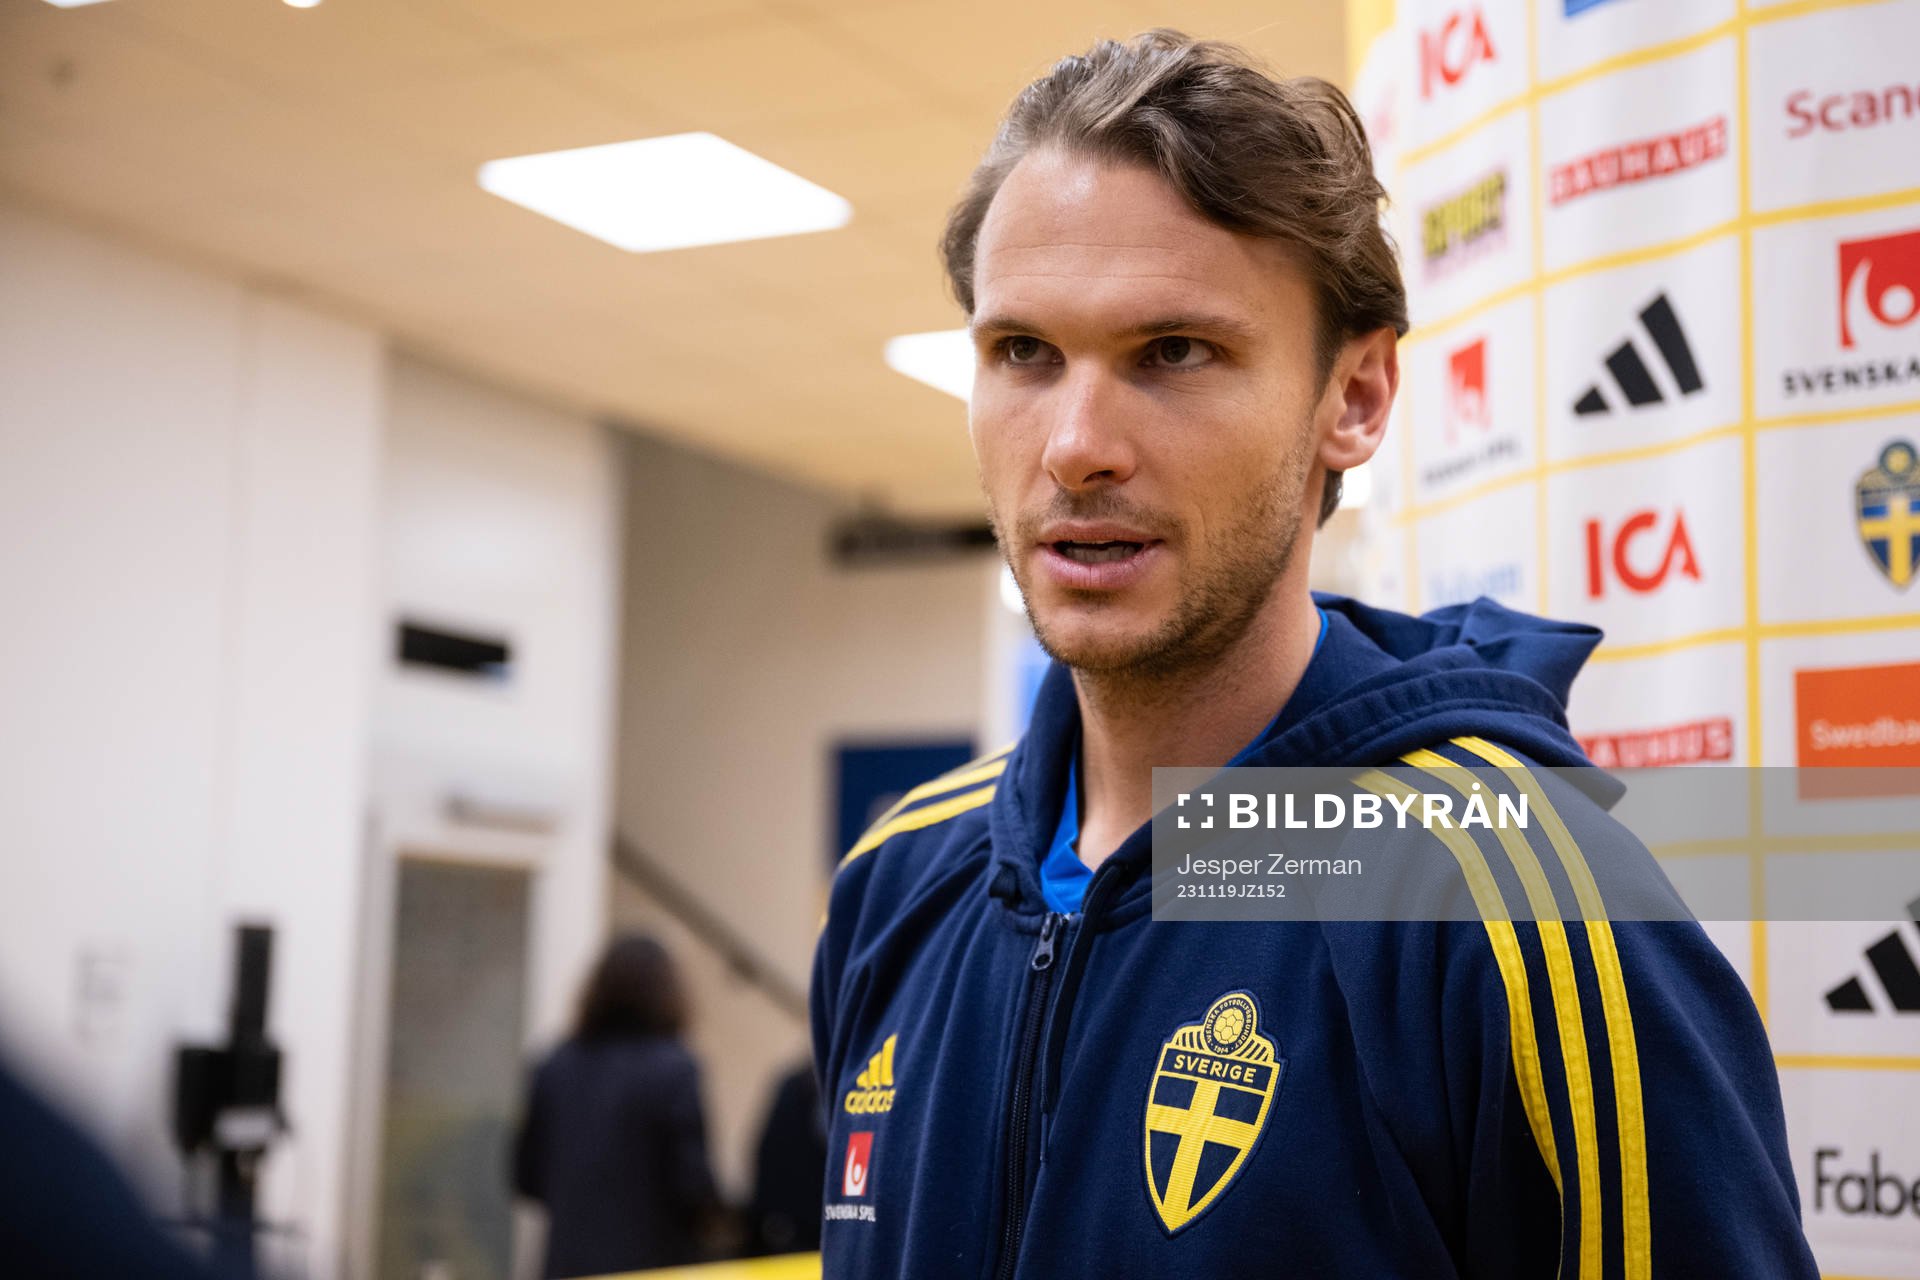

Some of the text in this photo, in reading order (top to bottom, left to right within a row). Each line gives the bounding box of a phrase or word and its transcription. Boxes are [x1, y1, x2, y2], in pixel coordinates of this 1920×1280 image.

[1420, 9, 1495, 99] ICA
[1785, 84, 1920, 138] Scan
[1586, 507, 1700, 600] ICA
[1580, 718, 1731, 769] AUHAUS
[1174, 1054, 1257, 1083] SVERIGE
[844, 1089, 896, 1114] adidas
